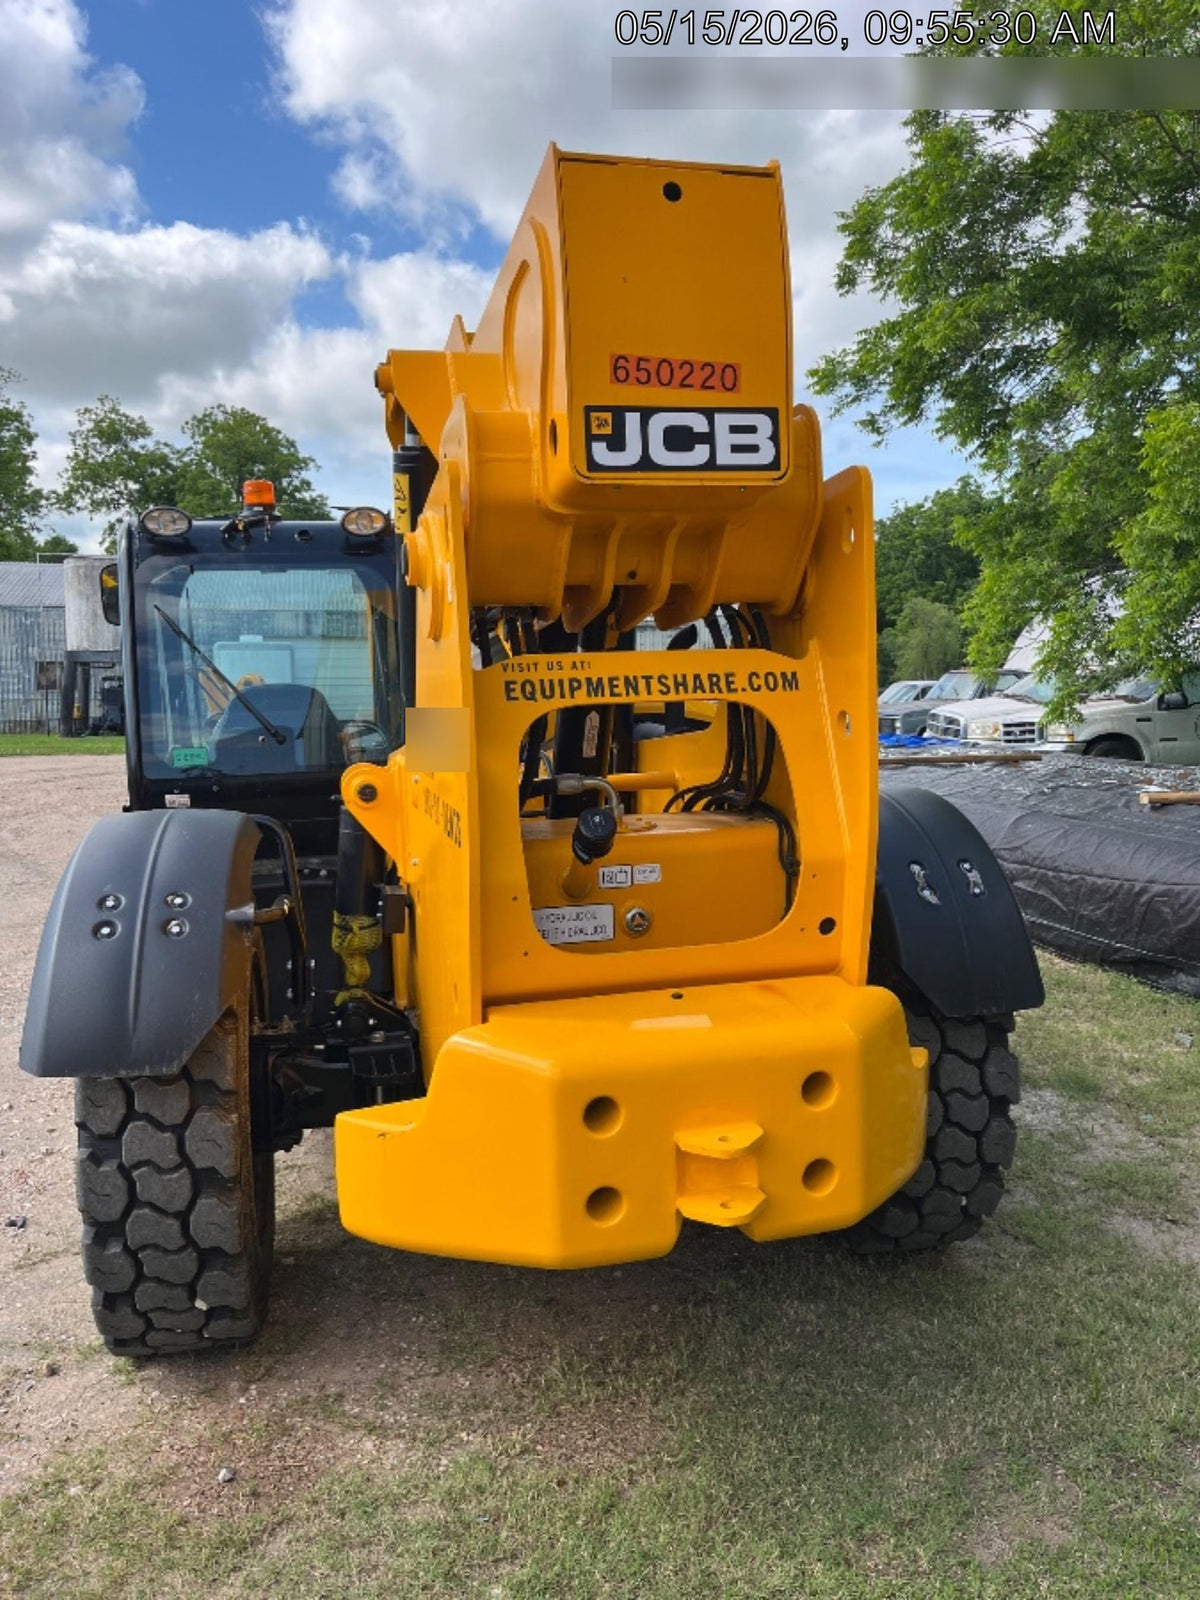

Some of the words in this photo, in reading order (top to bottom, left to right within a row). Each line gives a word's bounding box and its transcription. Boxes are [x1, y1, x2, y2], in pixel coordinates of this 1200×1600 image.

[612, 354, 738, 392] 650220
[591, 411, 776, 466] JCB
[501, 661, 539, 673] VISIT
[547, 661, 564, 671] US
[570, 660, 592, 671] AT:
[503, 671, 800, 703] EQUIPMENTSHARE.COM
